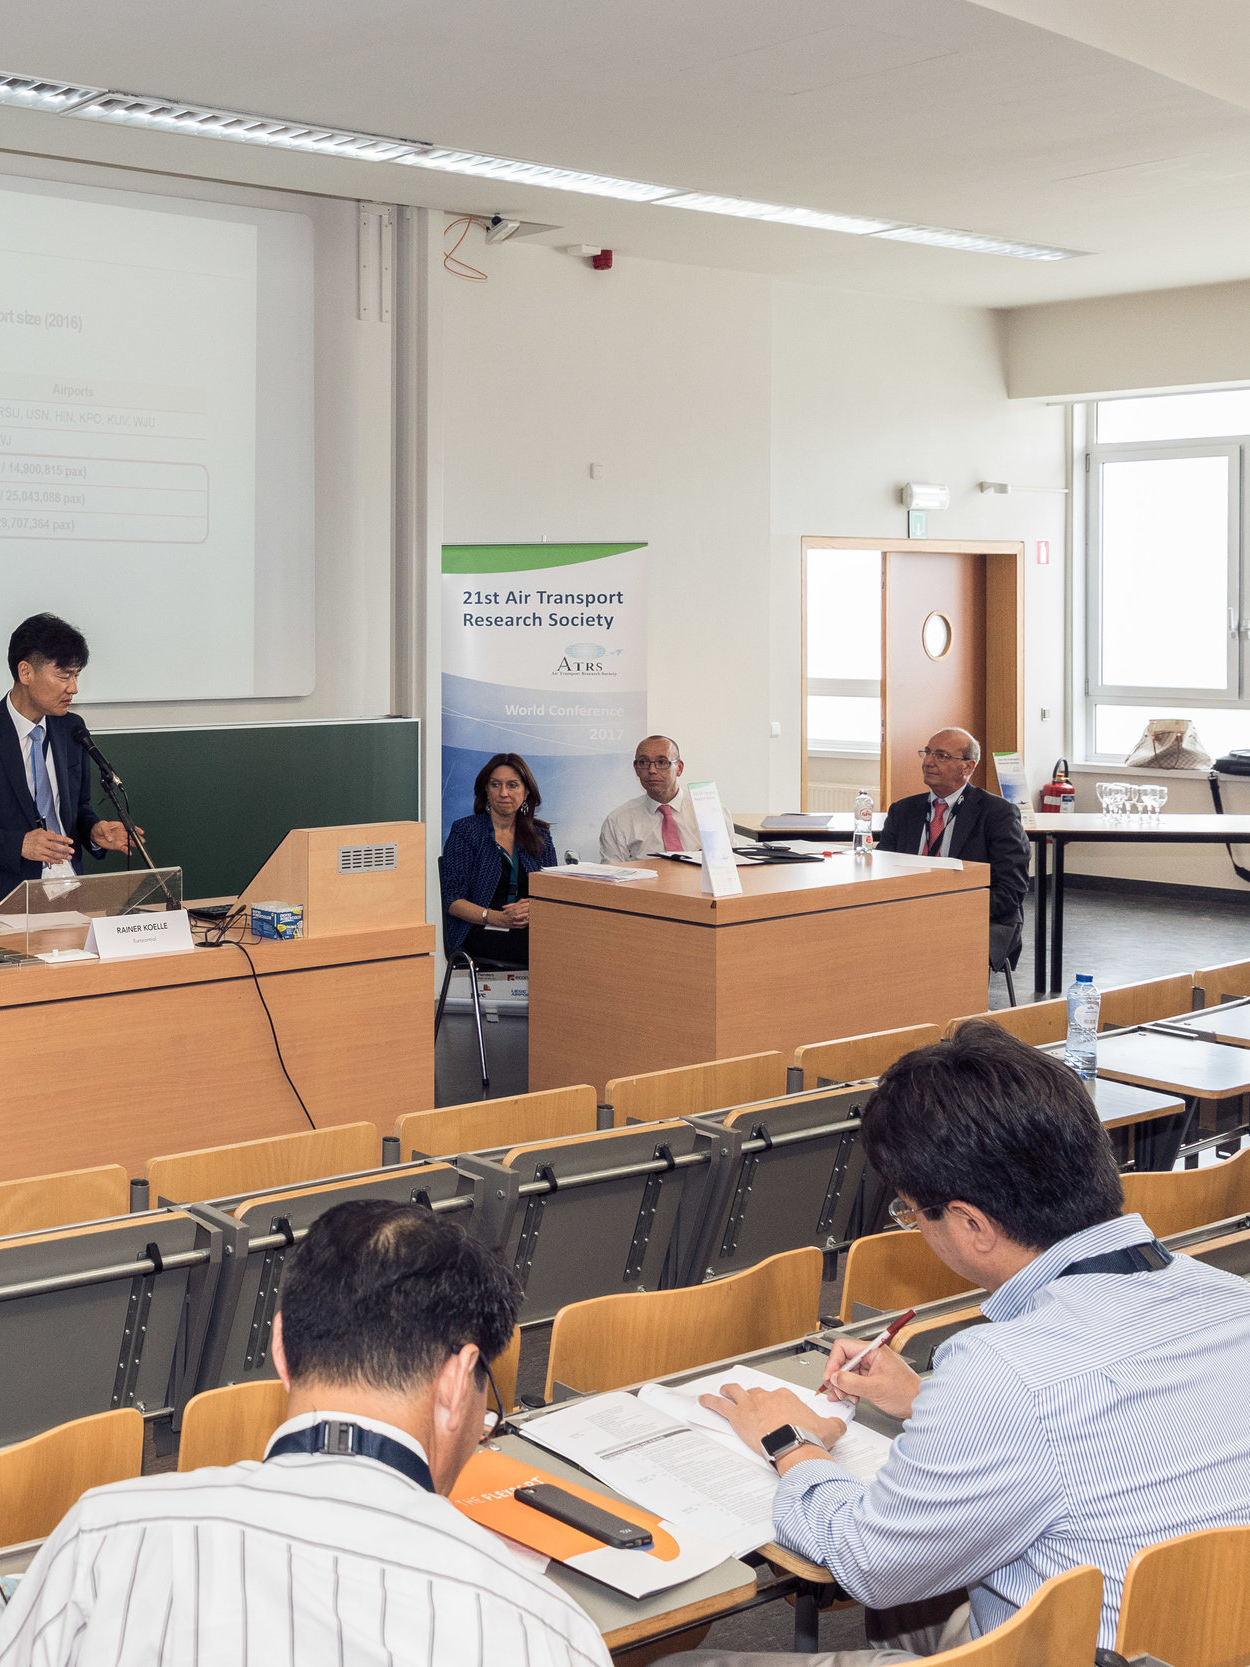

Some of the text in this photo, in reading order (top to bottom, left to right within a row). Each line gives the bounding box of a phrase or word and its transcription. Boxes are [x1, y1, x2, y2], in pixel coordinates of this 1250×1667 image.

[16, 310, 41, 326] size
[44, 312, 83, 333] (2016)
[52, 383, 95, 399] Airports
[65, 465, 87, 479] pax)
[63, 493, 85, 507] pax)
[52, 519, 75, 533] pax)
[463, 590, 624, 607] 21st Air Transport
[463, 612, 614, 630] Research Society
[505, 704, 625, 717] World Conference
[589, 728, 625, 741] 2017
[116, 922, 168, 934] RAINER KOELLE
